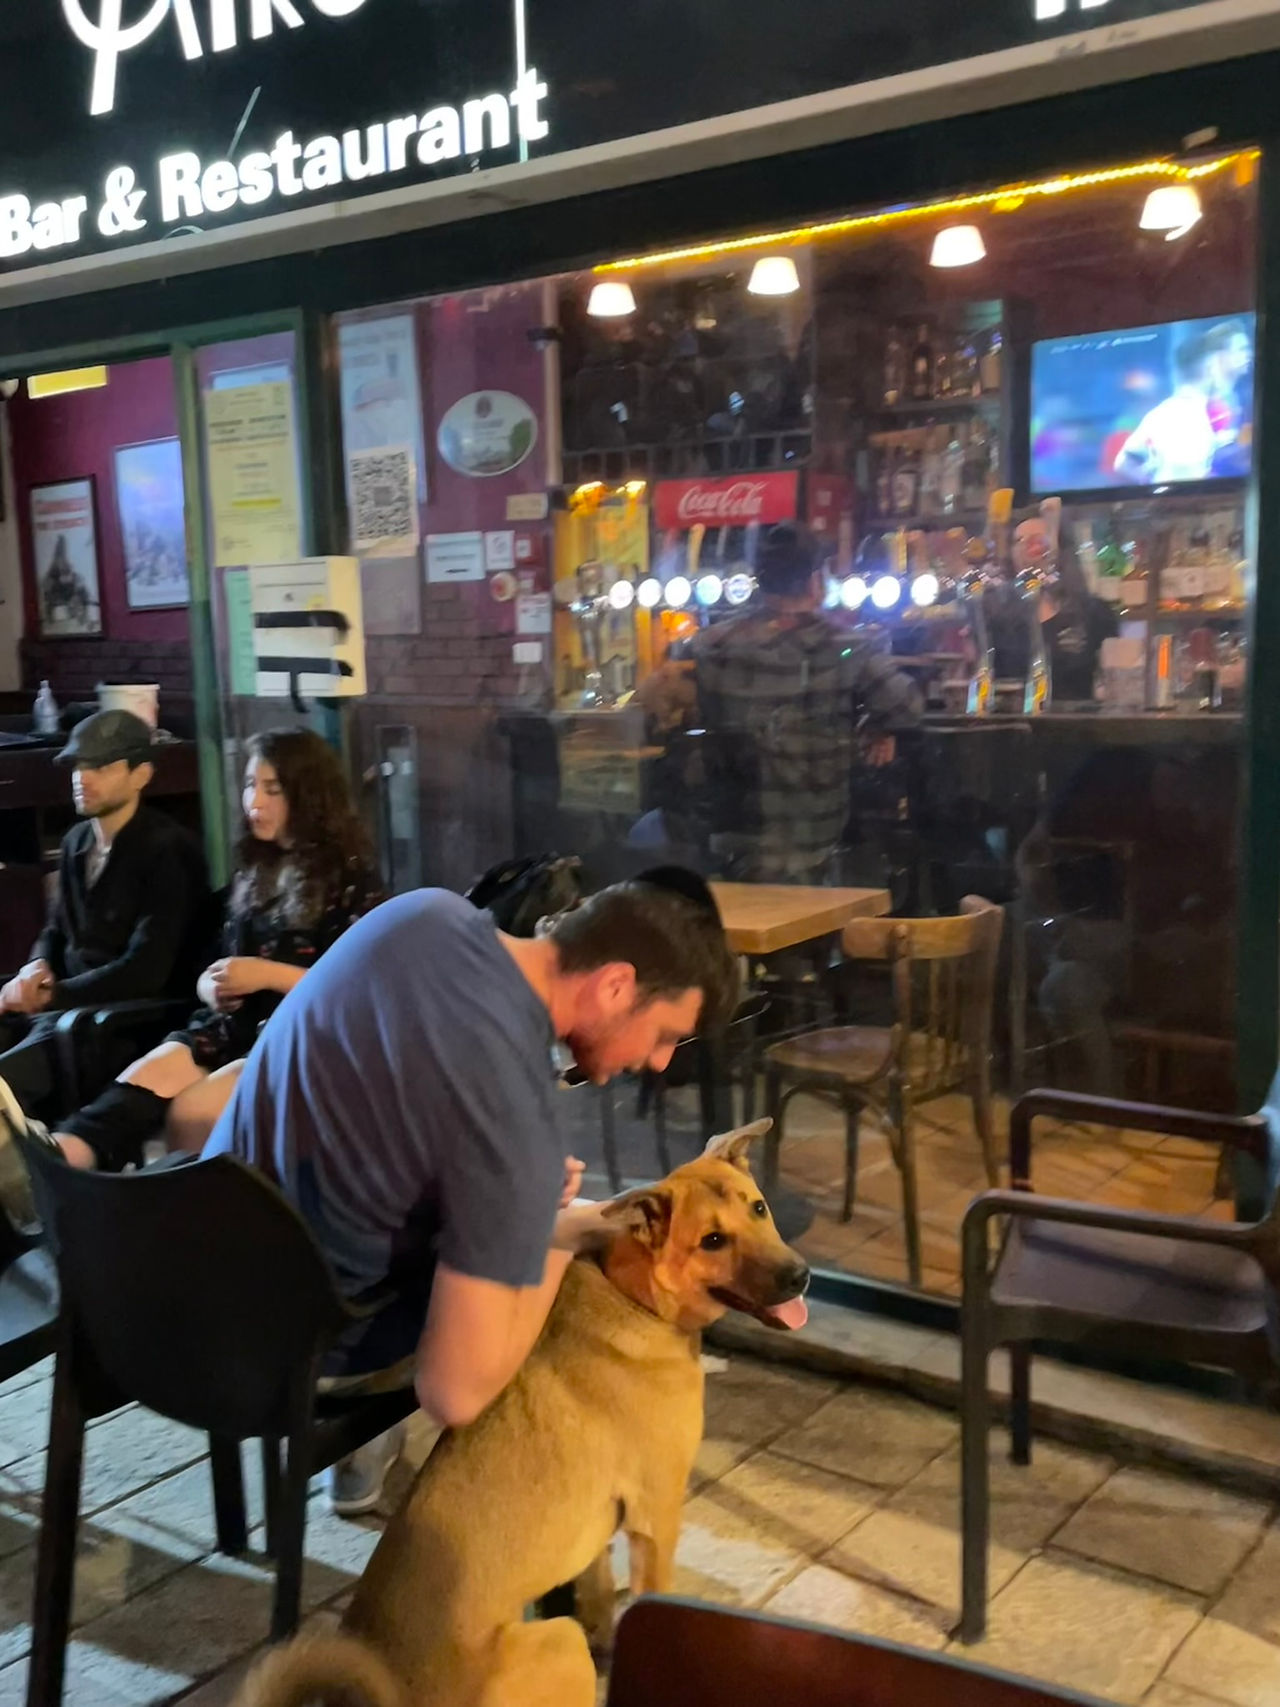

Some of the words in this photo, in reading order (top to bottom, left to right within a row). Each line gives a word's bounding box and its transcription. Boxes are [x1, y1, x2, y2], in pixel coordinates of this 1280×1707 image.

[0, 194, 88, 258] Bar
[97, 165, 148, 236] &
[158, 67, 549, 224] Restaurant
